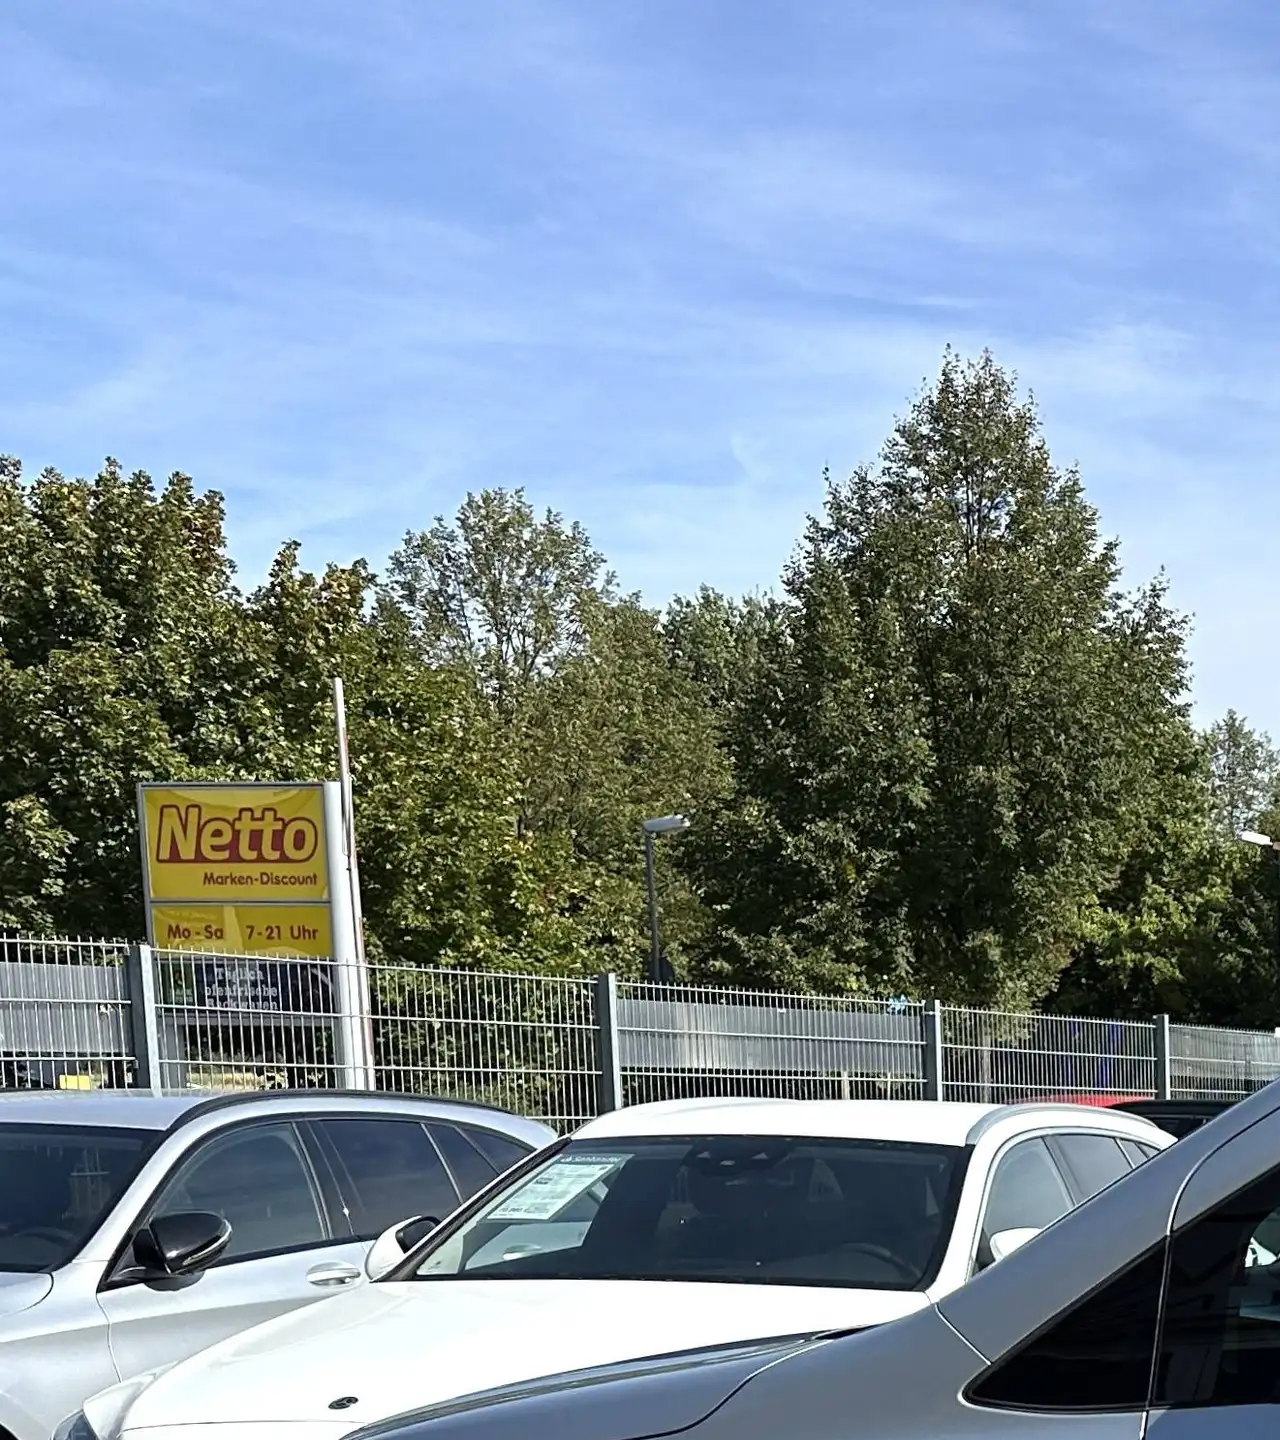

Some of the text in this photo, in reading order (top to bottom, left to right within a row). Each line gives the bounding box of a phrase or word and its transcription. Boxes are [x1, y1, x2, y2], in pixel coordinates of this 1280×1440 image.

[156, 804, 318, 863] Netto
[203, 872, 318, 886] Marken-Discount
[167, 924, 191, 940] Mo
[204, 924, 224, 940] Sa
[290, 924, 319, 941] Uhr
